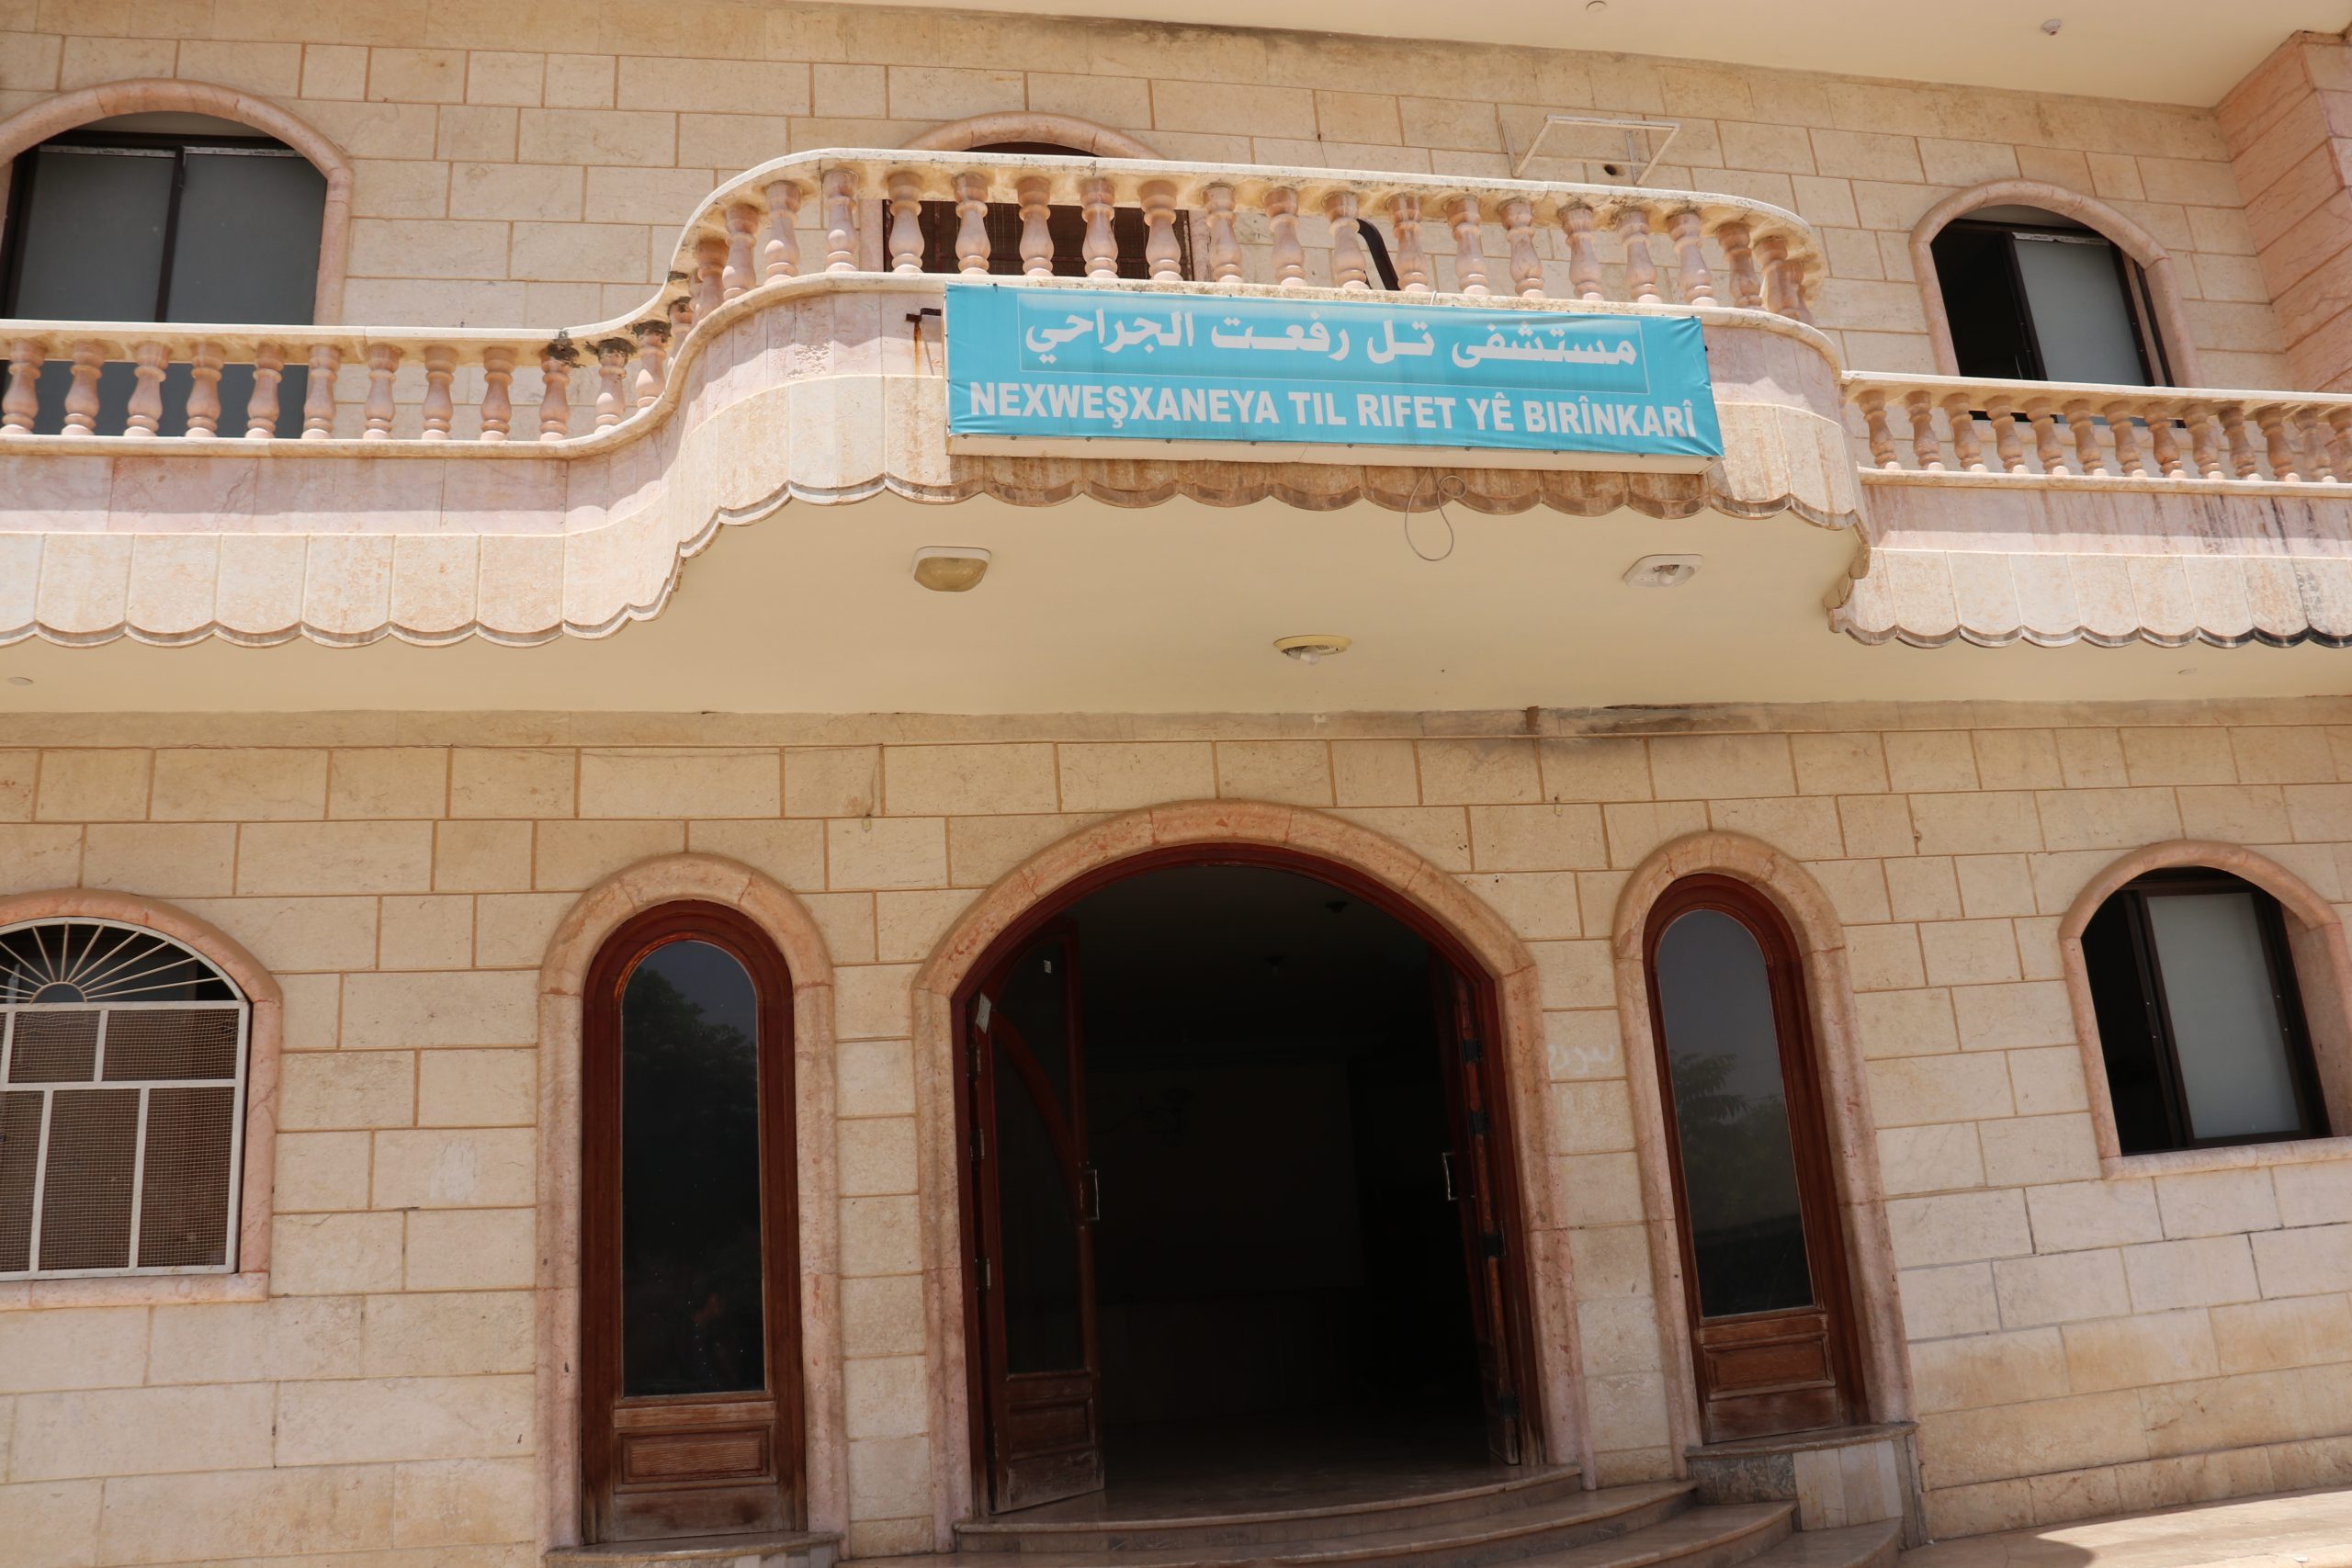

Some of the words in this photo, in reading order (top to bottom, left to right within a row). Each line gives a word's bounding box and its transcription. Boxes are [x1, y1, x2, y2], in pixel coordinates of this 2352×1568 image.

[1025, 308, 1194, 364] الجراحي
[1211, 310, 1350, 361] رفعت
[1366, 320, 1436, 364] تل
[1452, 321, 1637, 368] مستشفى
[969, 381, 1280, 429] NEXWEŞXANEYA
[1288, 391, 1348, 425] TIL
[1356, 393, 1456, 429] RIFET
[1466, 391, 1515, 432] YÊ
[1522, 394, 1698, 438] BIRÎNKARÎ
